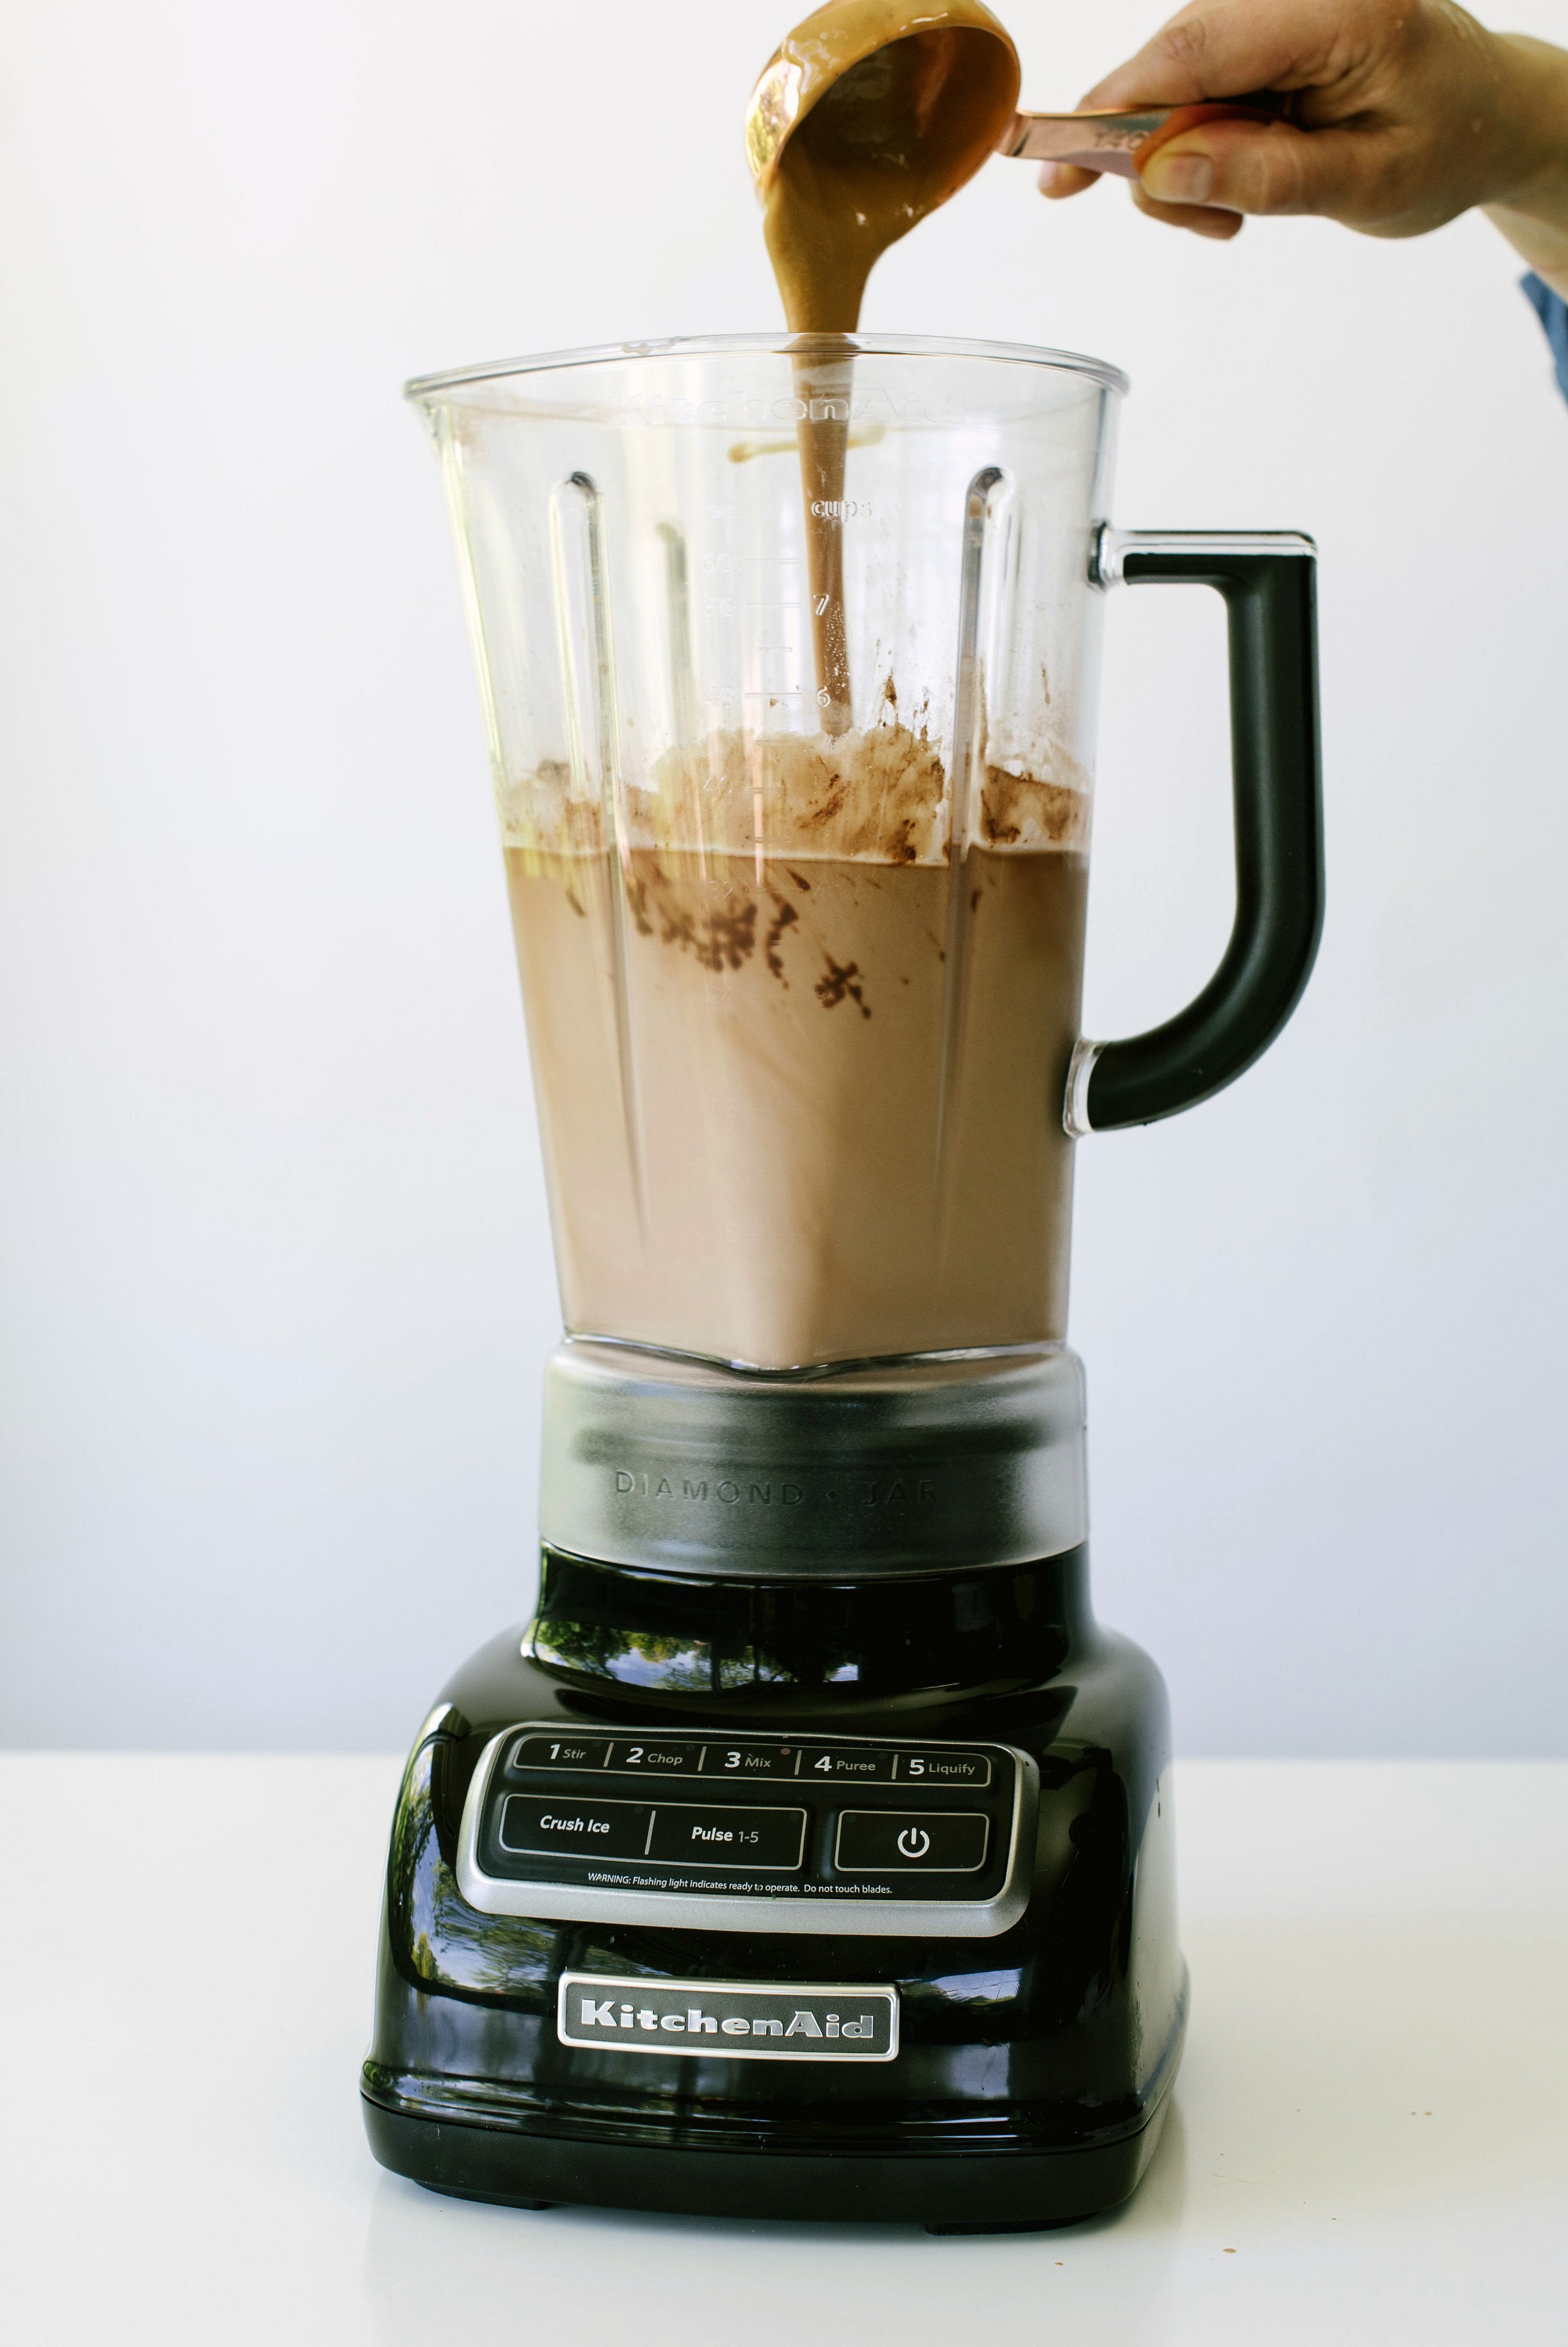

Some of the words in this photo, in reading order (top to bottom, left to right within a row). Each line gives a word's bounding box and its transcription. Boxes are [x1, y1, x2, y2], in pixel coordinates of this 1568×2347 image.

[811, 500, 872, 522] cups
[813, 593, 830, 615] 7
[816, 686, 831, 708] 6
[615, 1471, 803, 1505] DIAMOND
[865, 1480, 939, 1507] JAR
[551, 1744, 560, 1759] 1
[563, 1749, 585, 1758] Stir
[627, 1748, 643, 1763] 2
[648, 1754, 683, 1765] Chop
[725, 1752, 741, 1767] 3
[745, 1758, 771, 1767] Mix
[815, 1756, 832, 1771] 4
[837, 1761, 876, 1770] Puree
[910, 1760, 924, 1775] 5
[930, 1764, 975, 1775] Liquify
[540, 1815, 584, 1831] Crush
[587, 1820, 610, 1833] Ice
[692, 1827, 733, 1841] Pulse
[739, 1831, 758, 1842] 1-5
[588, 1872, 631, 1884] WARNING:
[632, 1876, 667, 1888] Flashing
[669, 1878, 688, 1889] light
[690, 1880, 727, 1889] indicates
[729, 1882, 752, 1892] ready
[863, 1885, 892, 1893] blades.
[581, 1998, 874, 2039] KitchenAid
